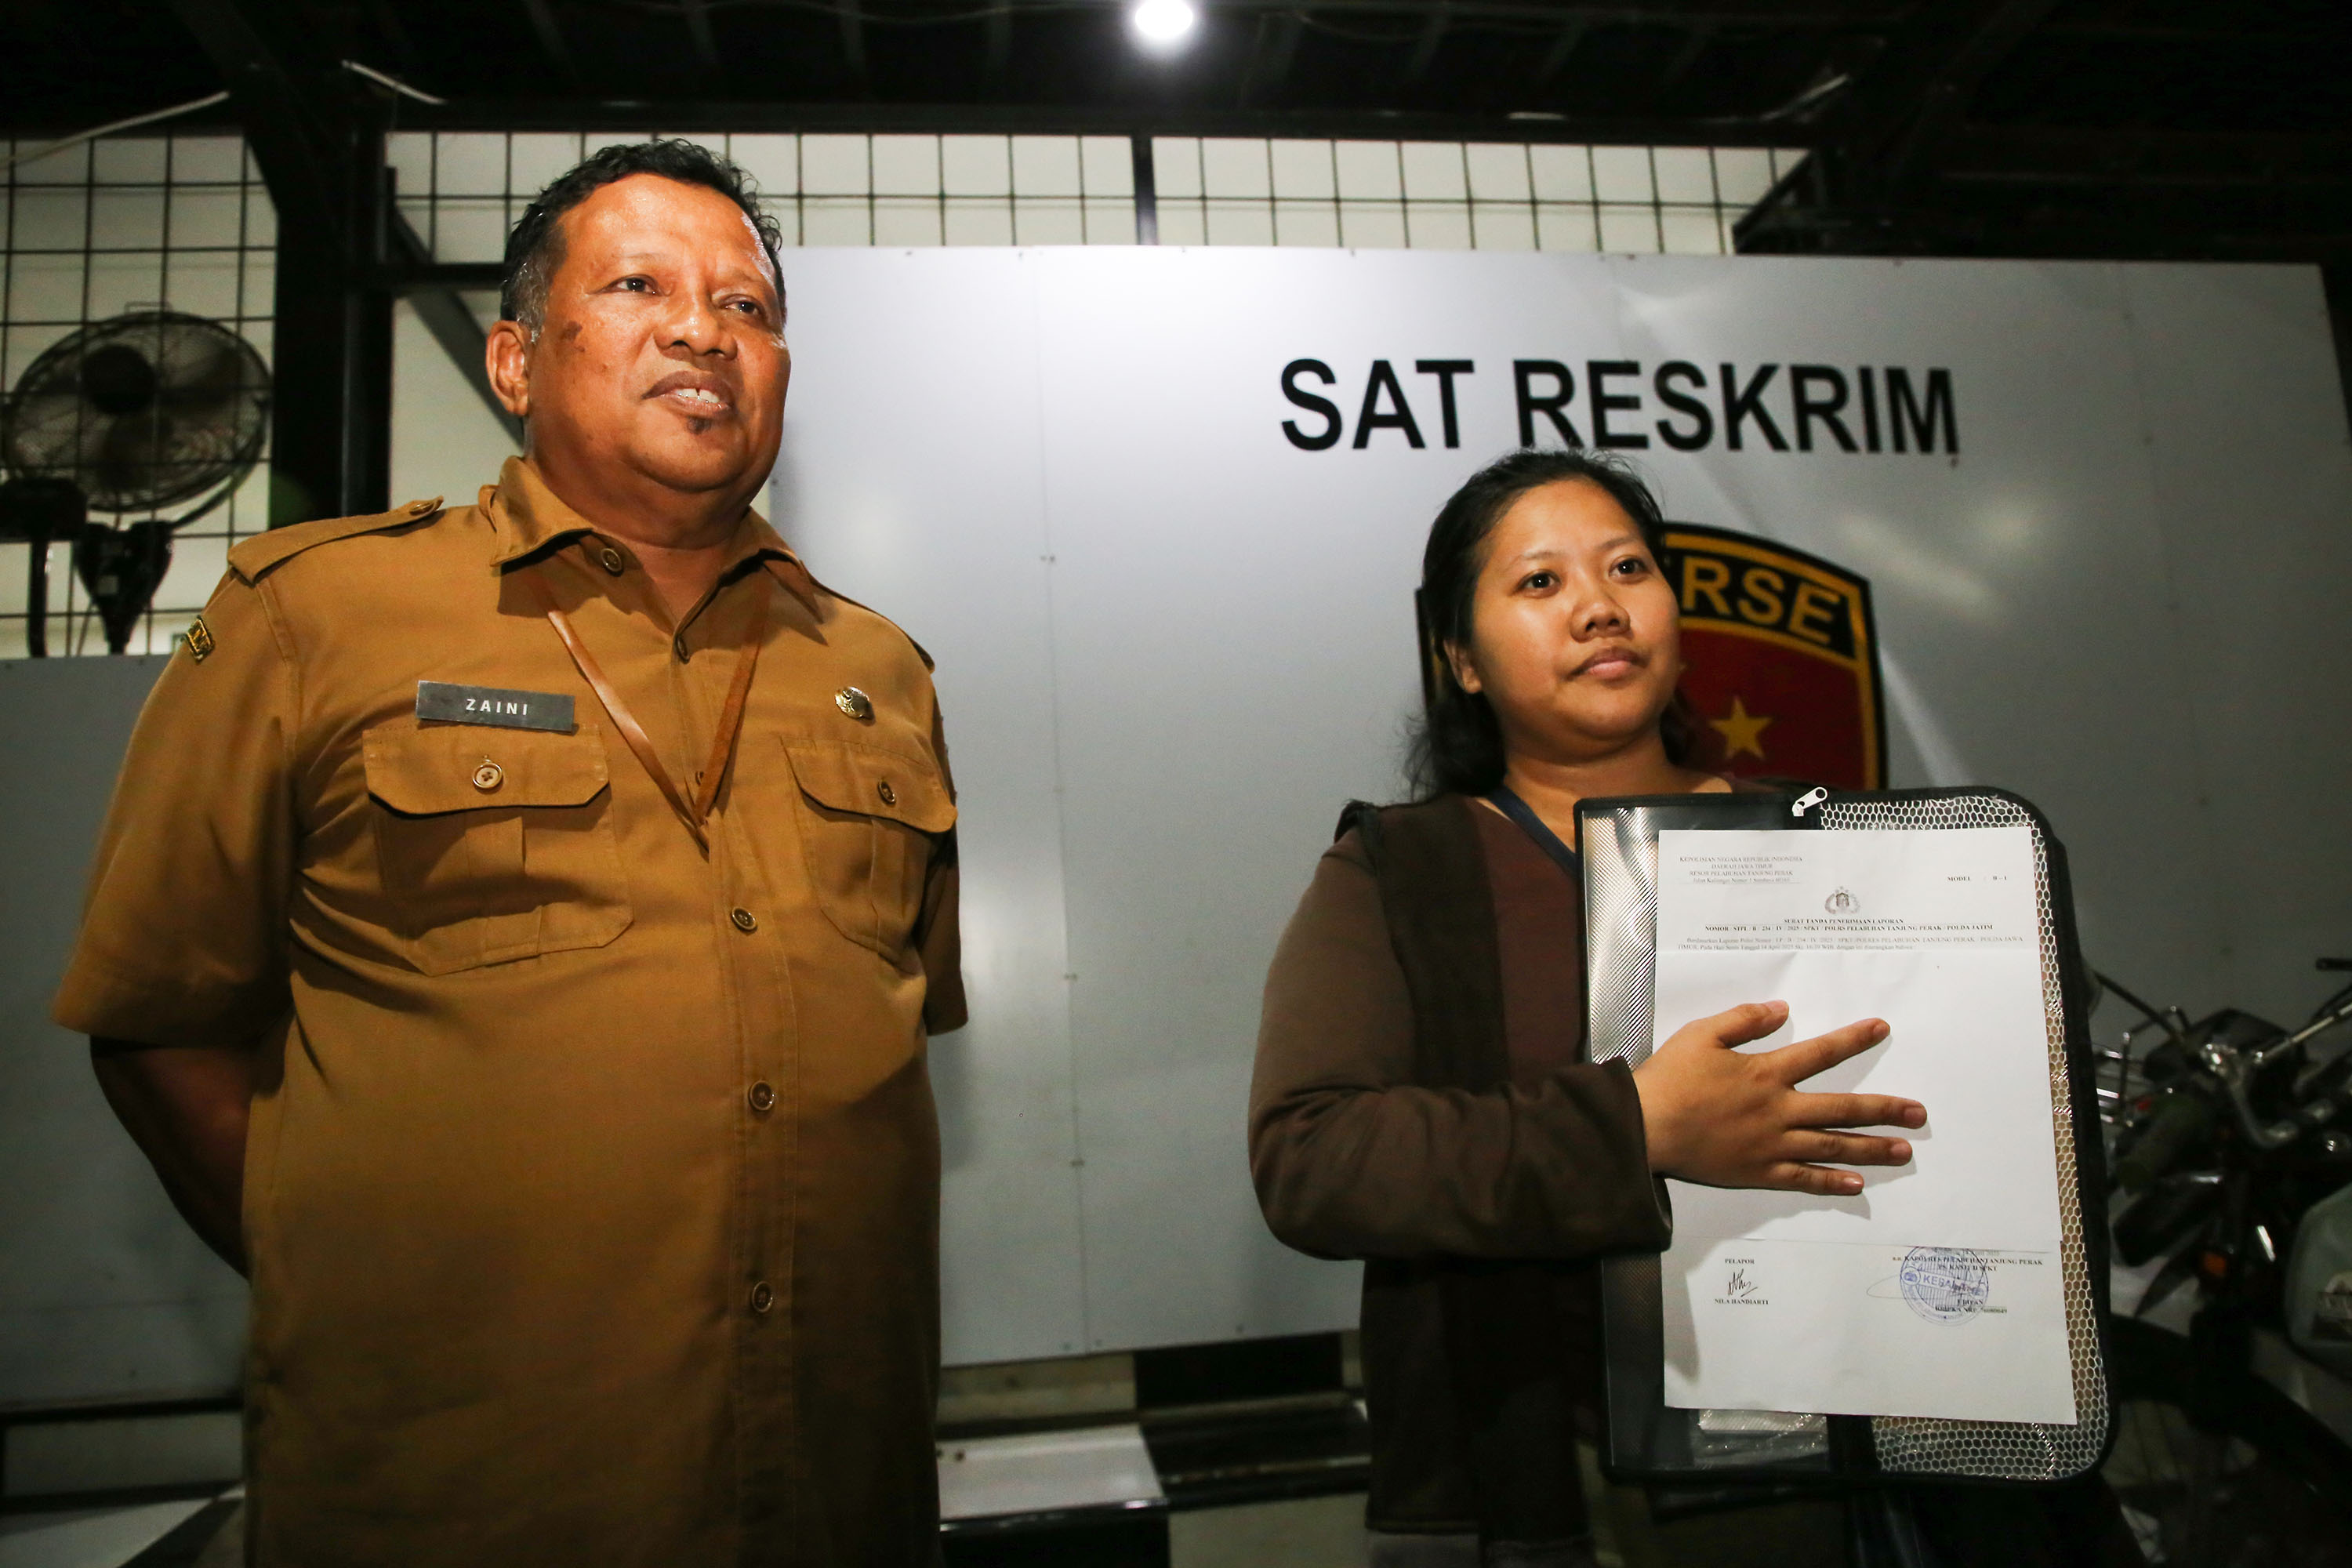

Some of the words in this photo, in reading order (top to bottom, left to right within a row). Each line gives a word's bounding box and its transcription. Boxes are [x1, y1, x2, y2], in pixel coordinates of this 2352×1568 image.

[1280, 358, 1475, 452] SAT
[1513, 358, 1960, 455] RESKRIM
[1682, 555, 1841, 644] RSE
[466, 698, 528, 716] ZAINI
